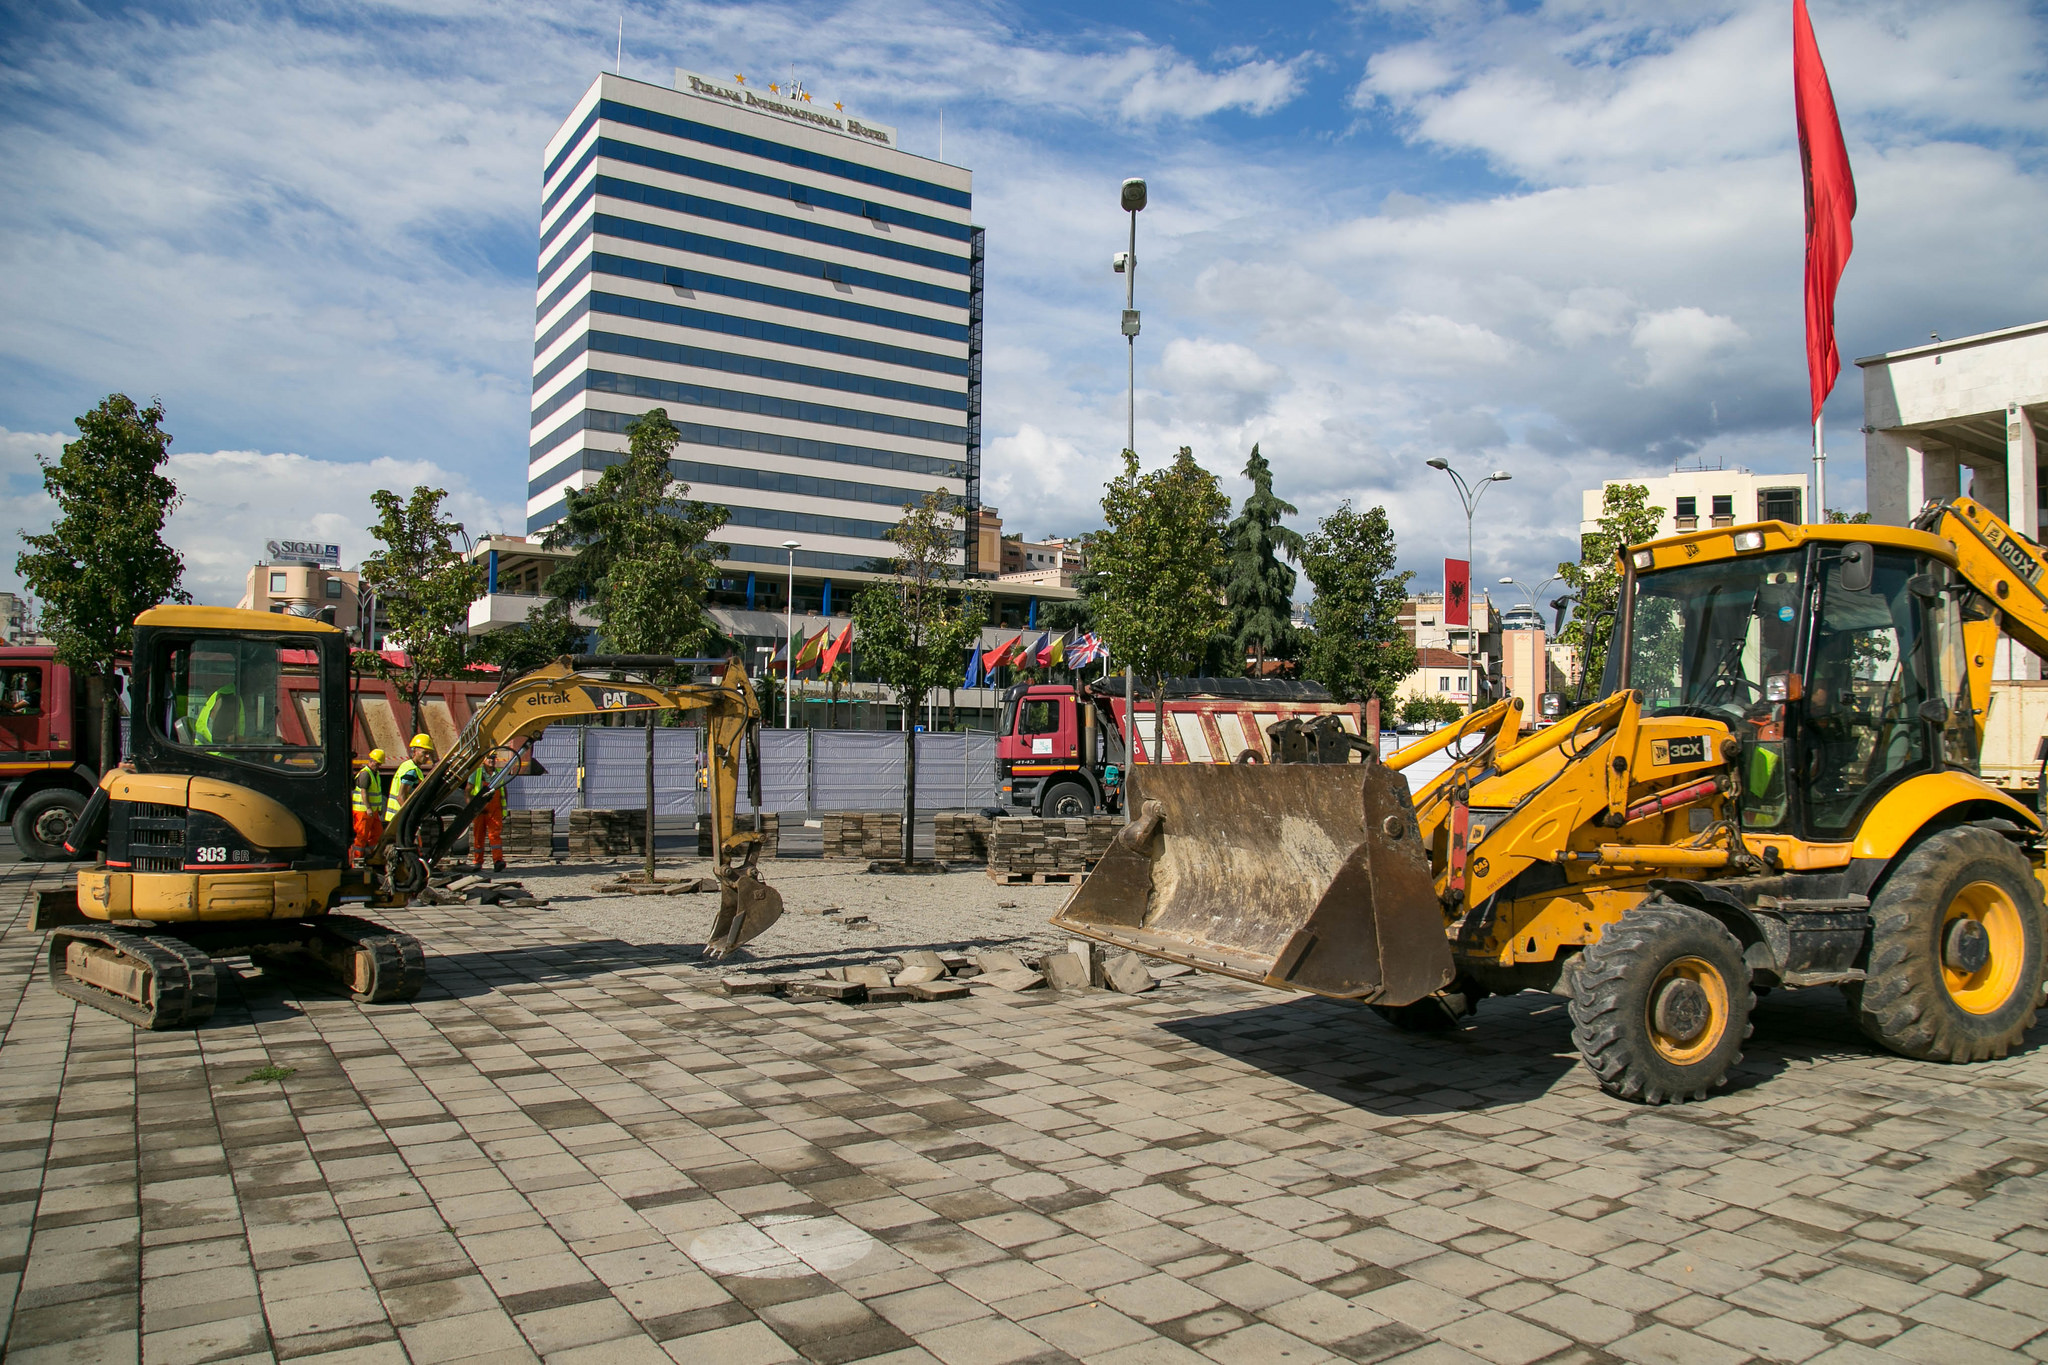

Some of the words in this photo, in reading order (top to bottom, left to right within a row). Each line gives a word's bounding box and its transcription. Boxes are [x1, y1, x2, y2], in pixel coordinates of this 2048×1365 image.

[281, 541, 324, 555] SIGAL
[527, 691, 571, 706] eltrak
[602, 692, 628, 709] CAT
[1670, 743, 1701, 758] 3CX
[197, 847, 227, 862] 303
[1473, 859, 1489, 873] RAS
